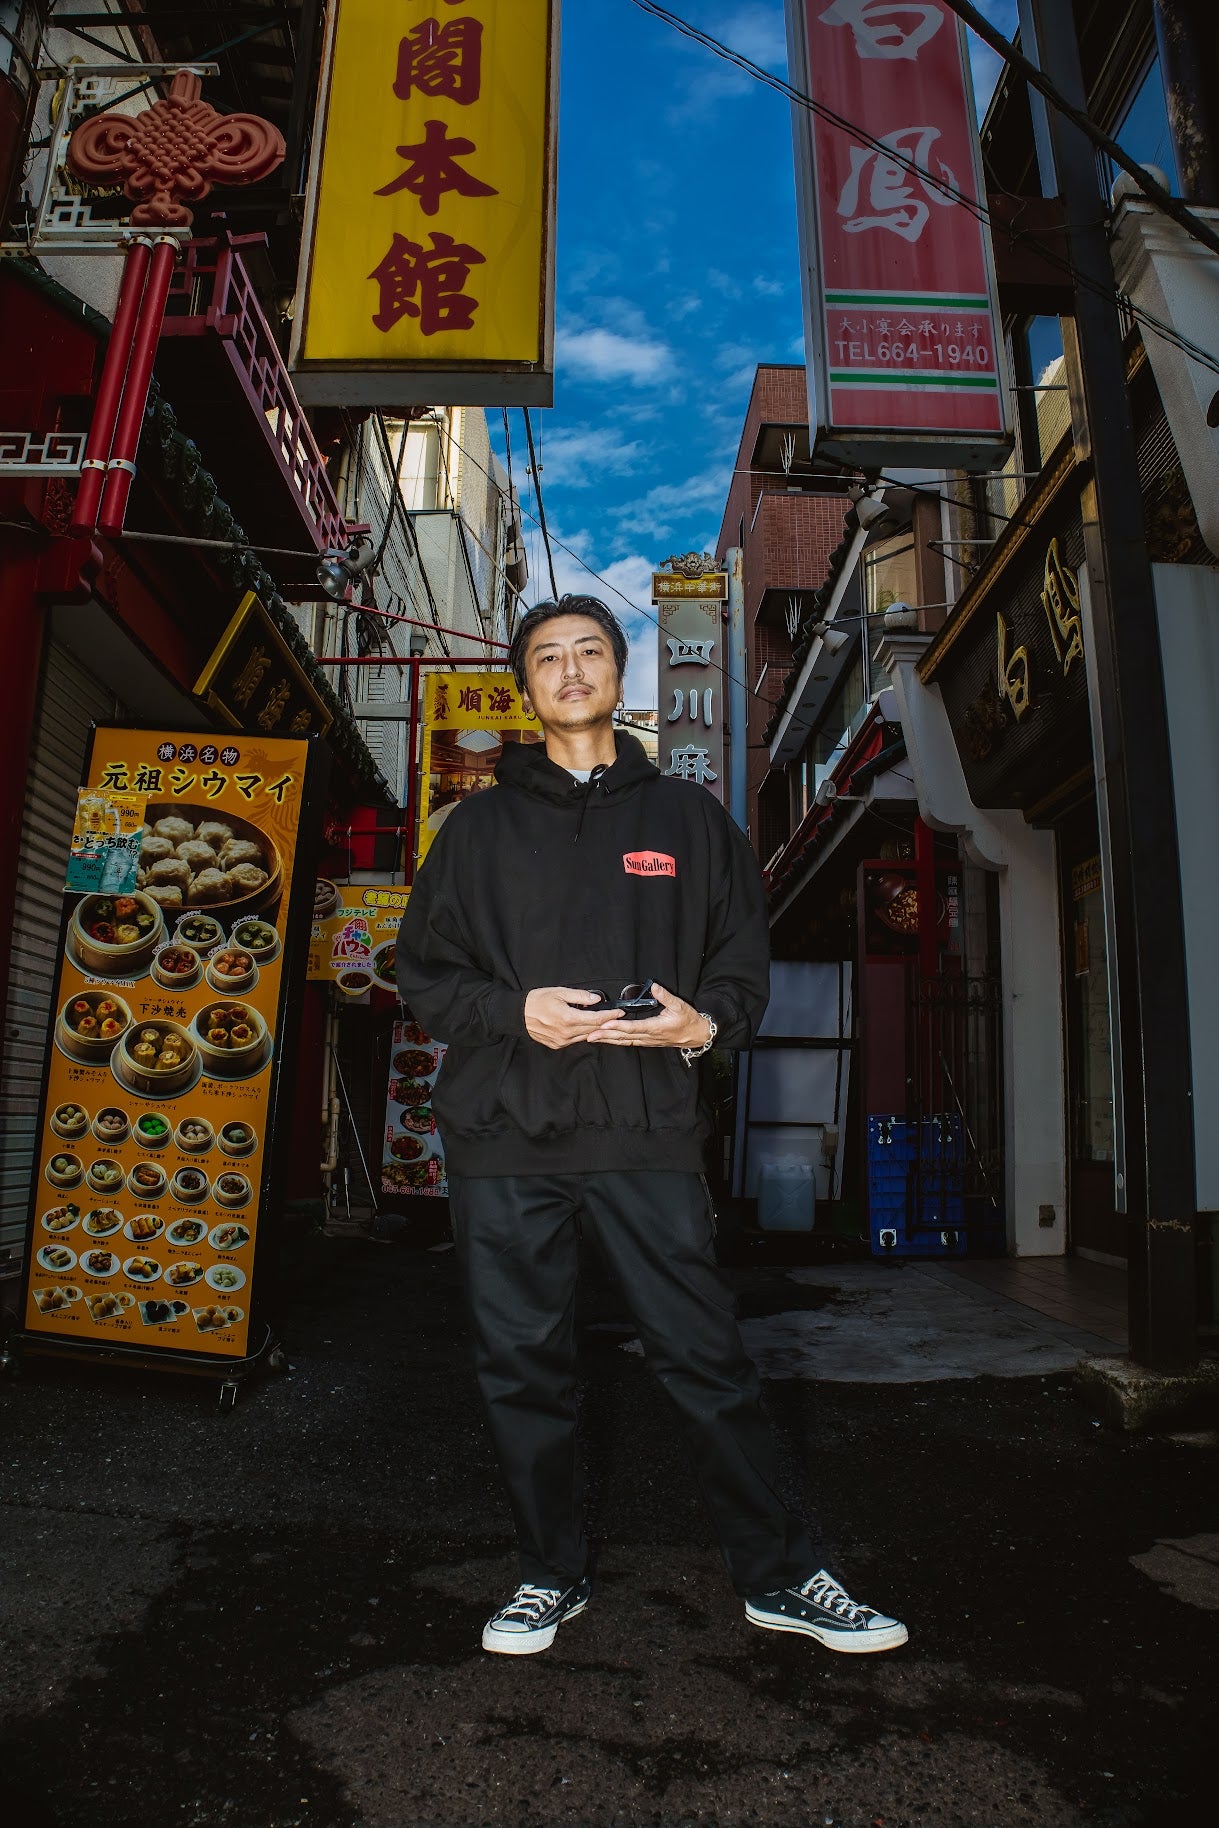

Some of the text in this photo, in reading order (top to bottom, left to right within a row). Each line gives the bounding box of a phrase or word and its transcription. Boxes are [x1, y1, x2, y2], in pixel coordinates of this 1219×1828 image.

[368, 0, 499, 337] 閣本館
[839, 316, 984, 340] 大小宴会承ります
[657, 581, 722, 594] 横浜中華街
[157, 744, 240, 766] 横浜名物
[100, 763, 293, 803] 元祖シウマイ
[337, 908, 377, 917] フジテレビ
